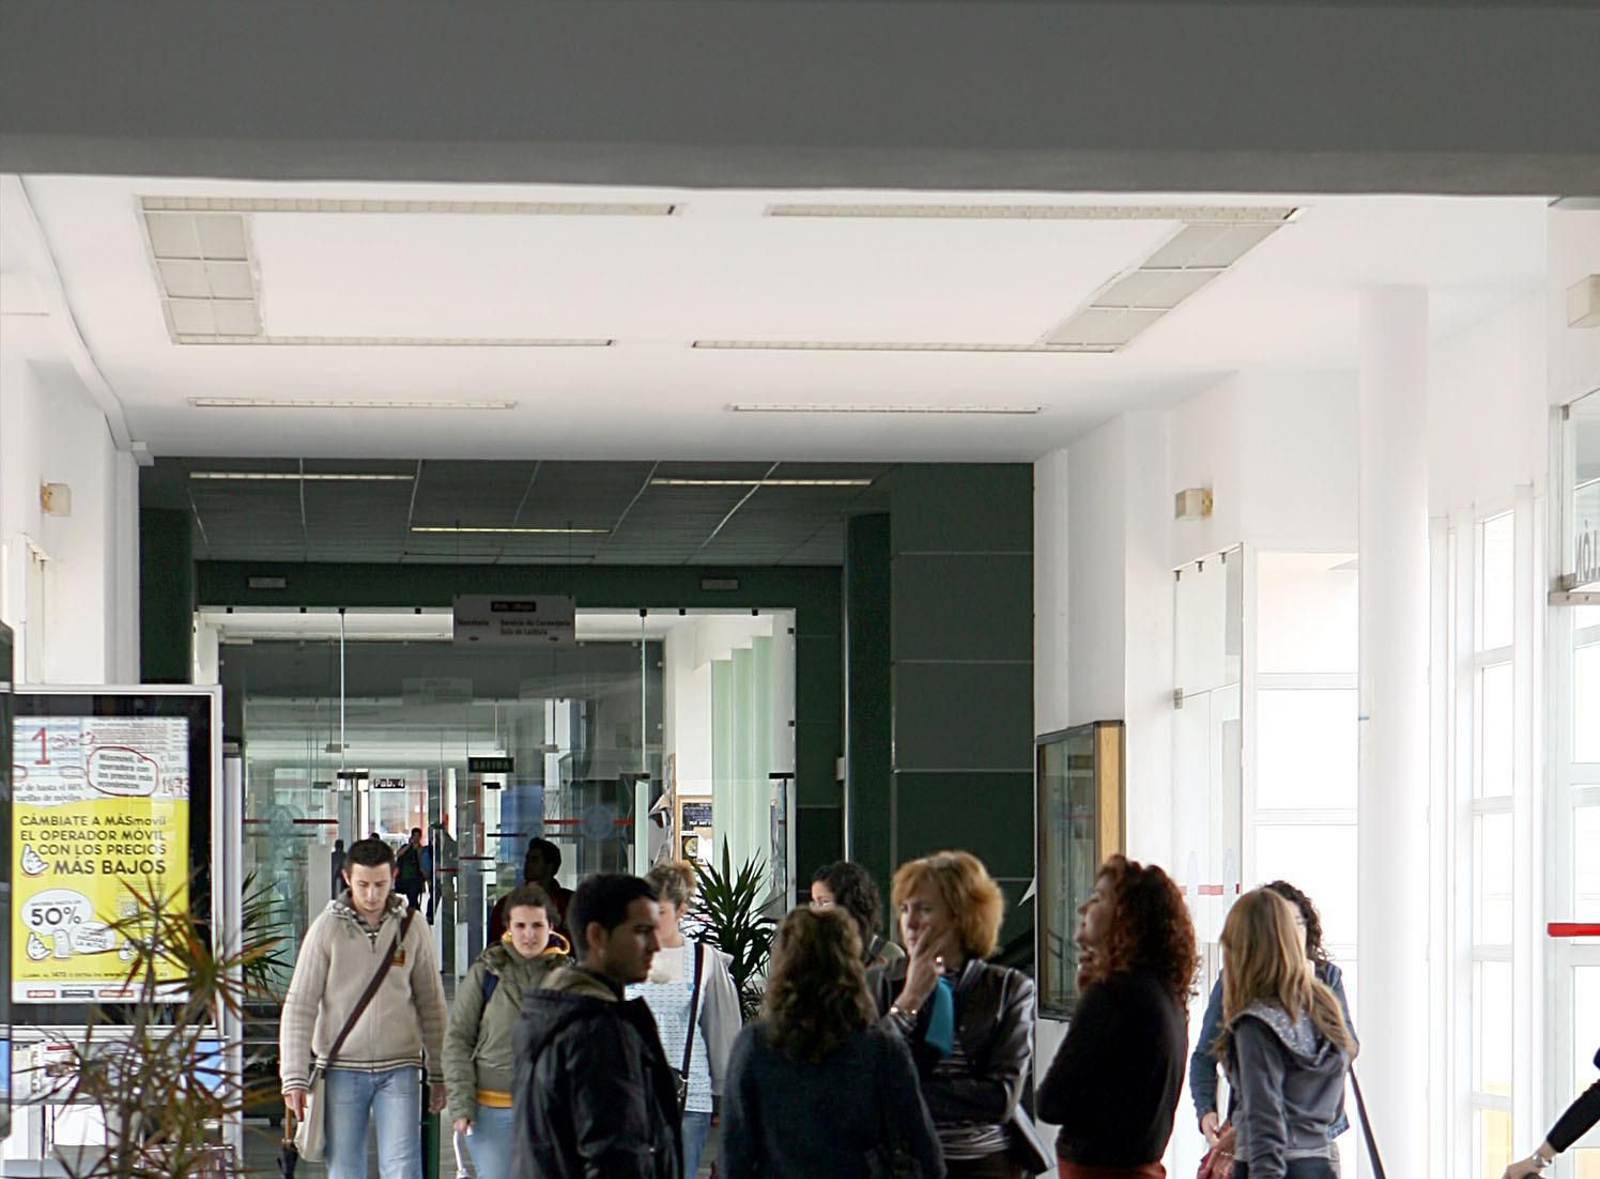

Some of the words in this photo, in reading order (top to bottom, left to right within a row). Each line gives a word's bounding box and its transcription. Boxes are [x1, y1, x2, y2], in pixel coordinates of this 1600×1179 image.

[92, 816, 100, 826] A
[20, 830, 36, 841] EL
[40, 830, 117, 841] OPERADOR
[121, 828, 166, 841] MÓVIL
[38, 844, 70, 855] CON
[75, 844, 102, 855] LOS
[107, 844, 166, 855] PRECIOS
[53, 856, 95, 875] MÁS
[102, 860, 166, 875] BAJOS
[31, 906, 81, 926] 50%
